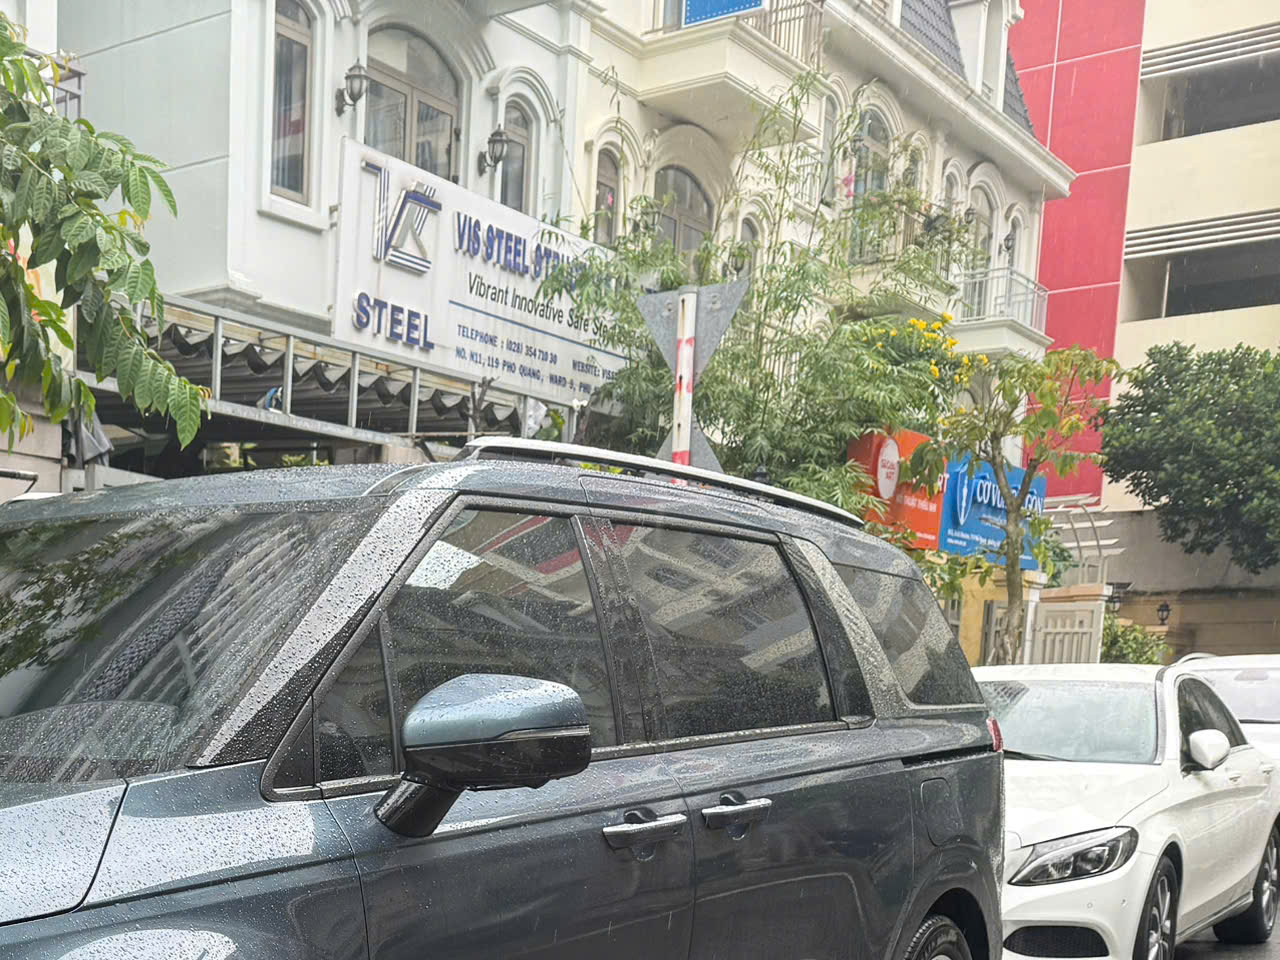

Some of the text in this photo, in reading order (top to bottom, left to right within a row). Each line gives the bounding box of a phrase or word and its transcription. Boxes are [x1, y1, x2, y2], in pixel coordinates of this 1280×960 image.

[455, 211, 481, 257] VIS
[483, 223, 529, 276] STEEL
[352, 292, 435, 351] STEEL
[468, 272, 509, 307] Vibrant
[511, 287, 564, 324] Innovative
[567, 308, 589, 333] Safe
[455, 346, 468, 361] NO.
[487, 356, 500, 369] 119
[502, 360, 516, 374] PHO
[549, 373, 567, 388] WARD
[457, 324, 498, 348] TELEPHONE
[525, 345, 537, 358] 354
[572, 359, 601, 377] WEBSITE:
[992, 482, 1007, 509] VU
